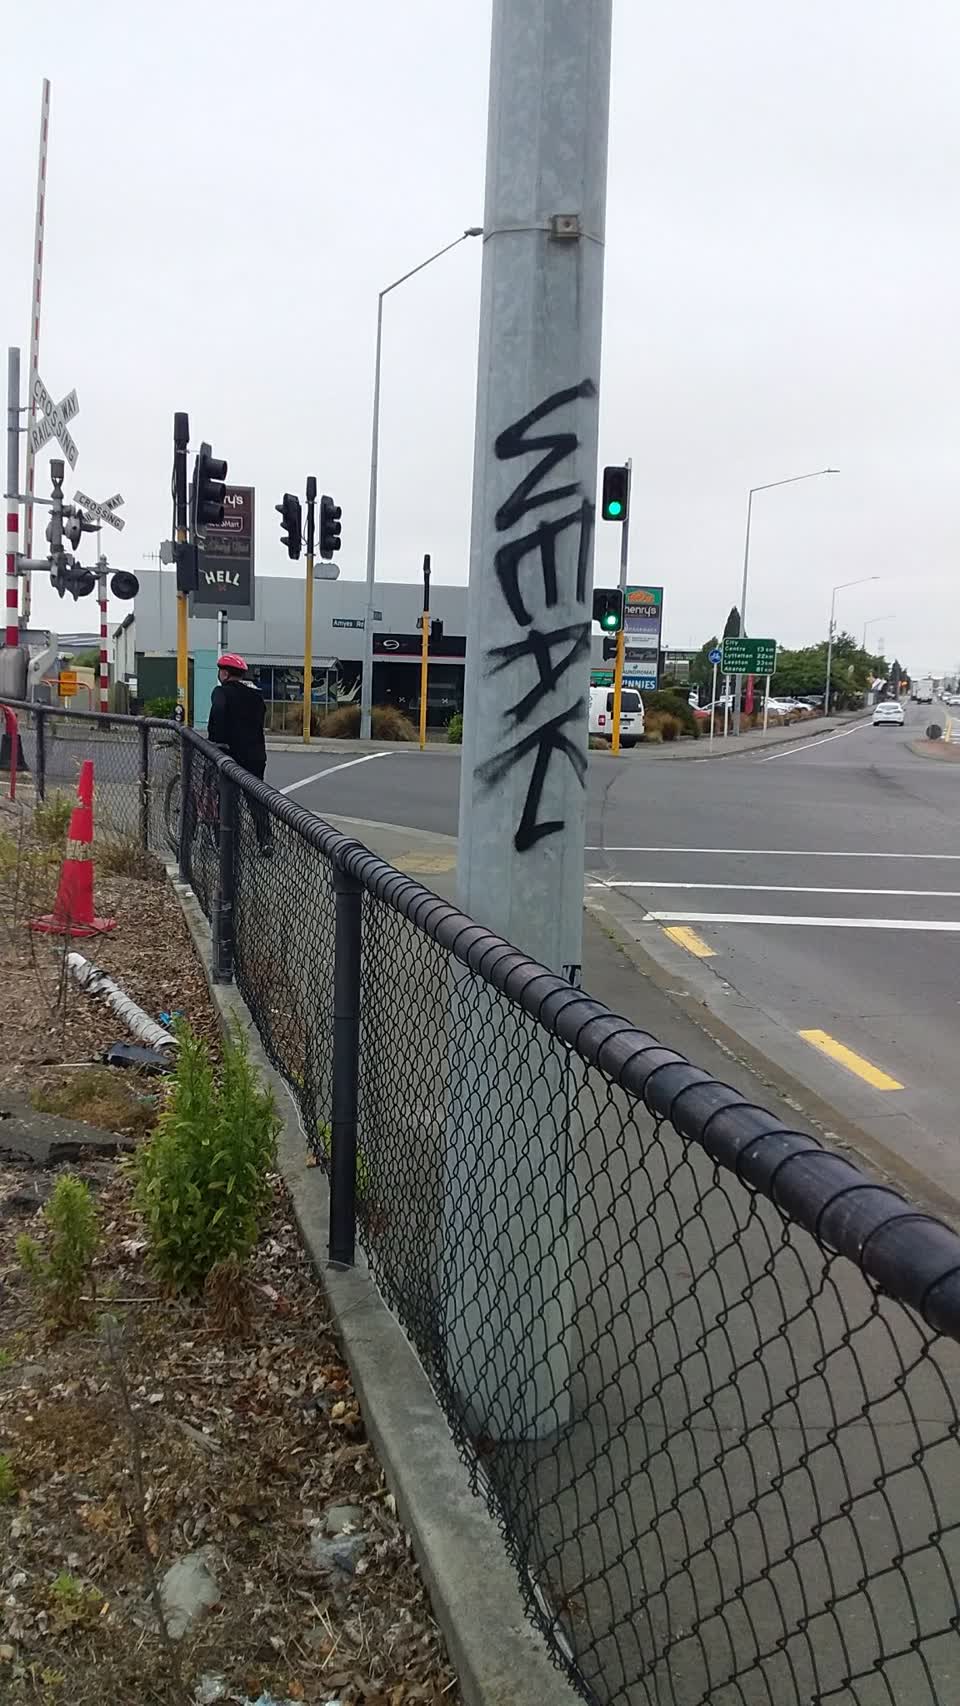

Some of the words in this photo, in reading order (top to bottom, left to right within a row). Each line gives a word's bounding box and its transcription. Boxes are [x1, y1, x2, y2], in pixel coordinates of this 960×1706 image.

[32, 423, 52, 449] RAIL
[62, 394, 77, 421] WAY
[34, 379, 76, 462] CROSSING
[79, 495, 121, 527] CROSSING
[224, 494, 244, 509] ry's
[205, 570, 240, 586] HELL
